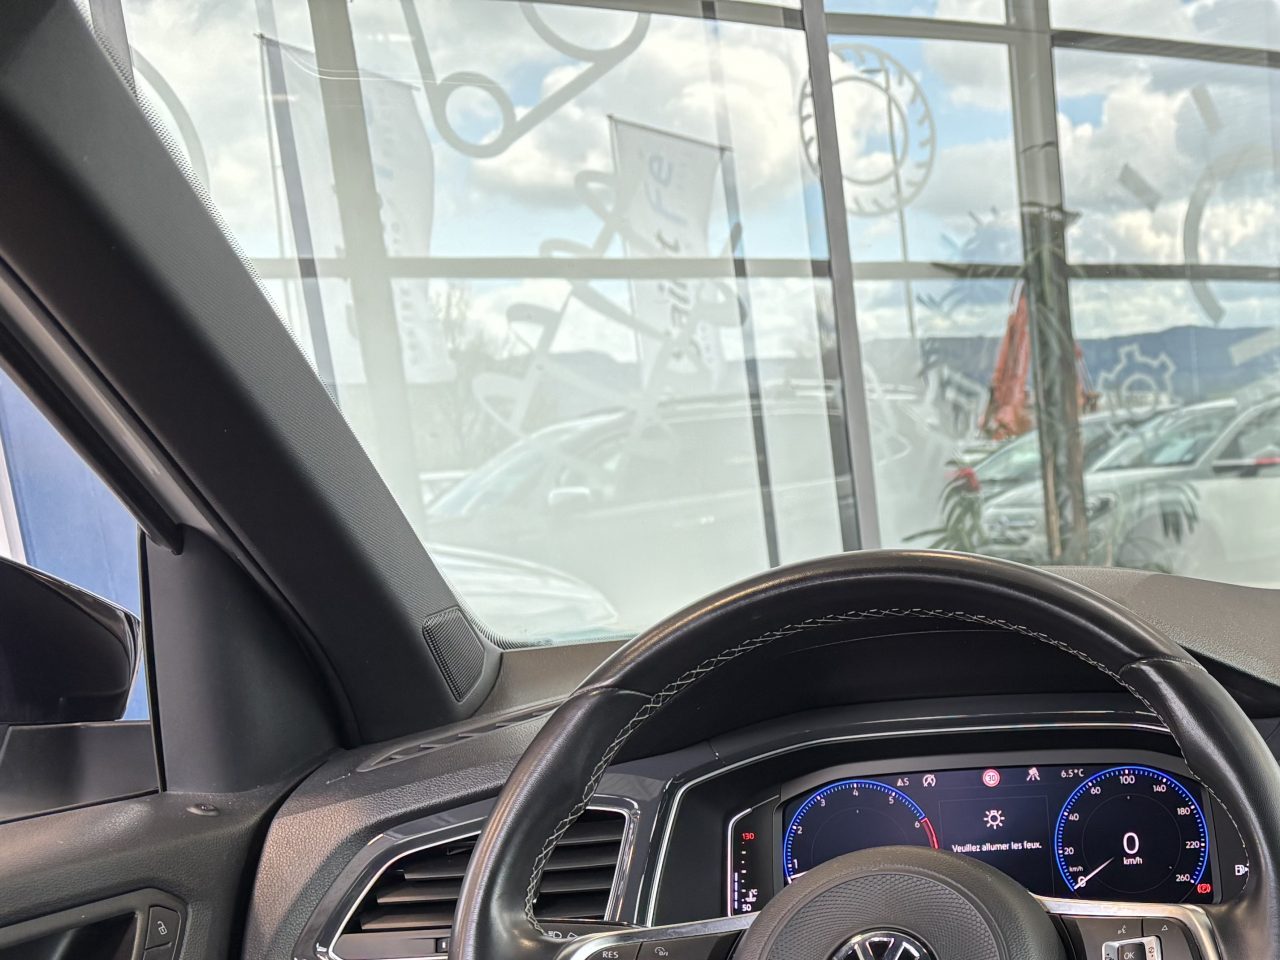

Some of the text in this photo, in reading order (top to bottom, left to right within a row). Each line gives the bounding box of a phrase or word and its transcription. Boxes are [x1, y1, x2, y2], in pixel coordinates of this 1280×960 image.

[1120, 776, 1135, 785] 100
[1091, 786, 1101, 795] 60
[1153, 784, 1167, 793] 140
[852, 789, 858, 797] 4
[820, 799, 825, 807] 3
[888, 796, 894, 805] 5
[1177, 806, 1191, 816] 180
[1069, 813, 1079, 821] 40
[914, 820, 920, 828] 6
[797, 826, 803, 835] 2
[742, 832, 755, 840] 130
[952, 844, 980, 853] Veuillez
[982, 842, 1009, 852] allumer
[1011, 841, 1022, 850] les
[1122, 832, 1140, 854] 0
[1185, 841, 1200, 849] 220
[1064, 847, 1074, 855] 20
[1123, 857, 1143, 865] km/h
[1175, 874, 1190, 883] 260
[742, 904, 752, 912] 50
[1123, 952, 1135, 960] OK
